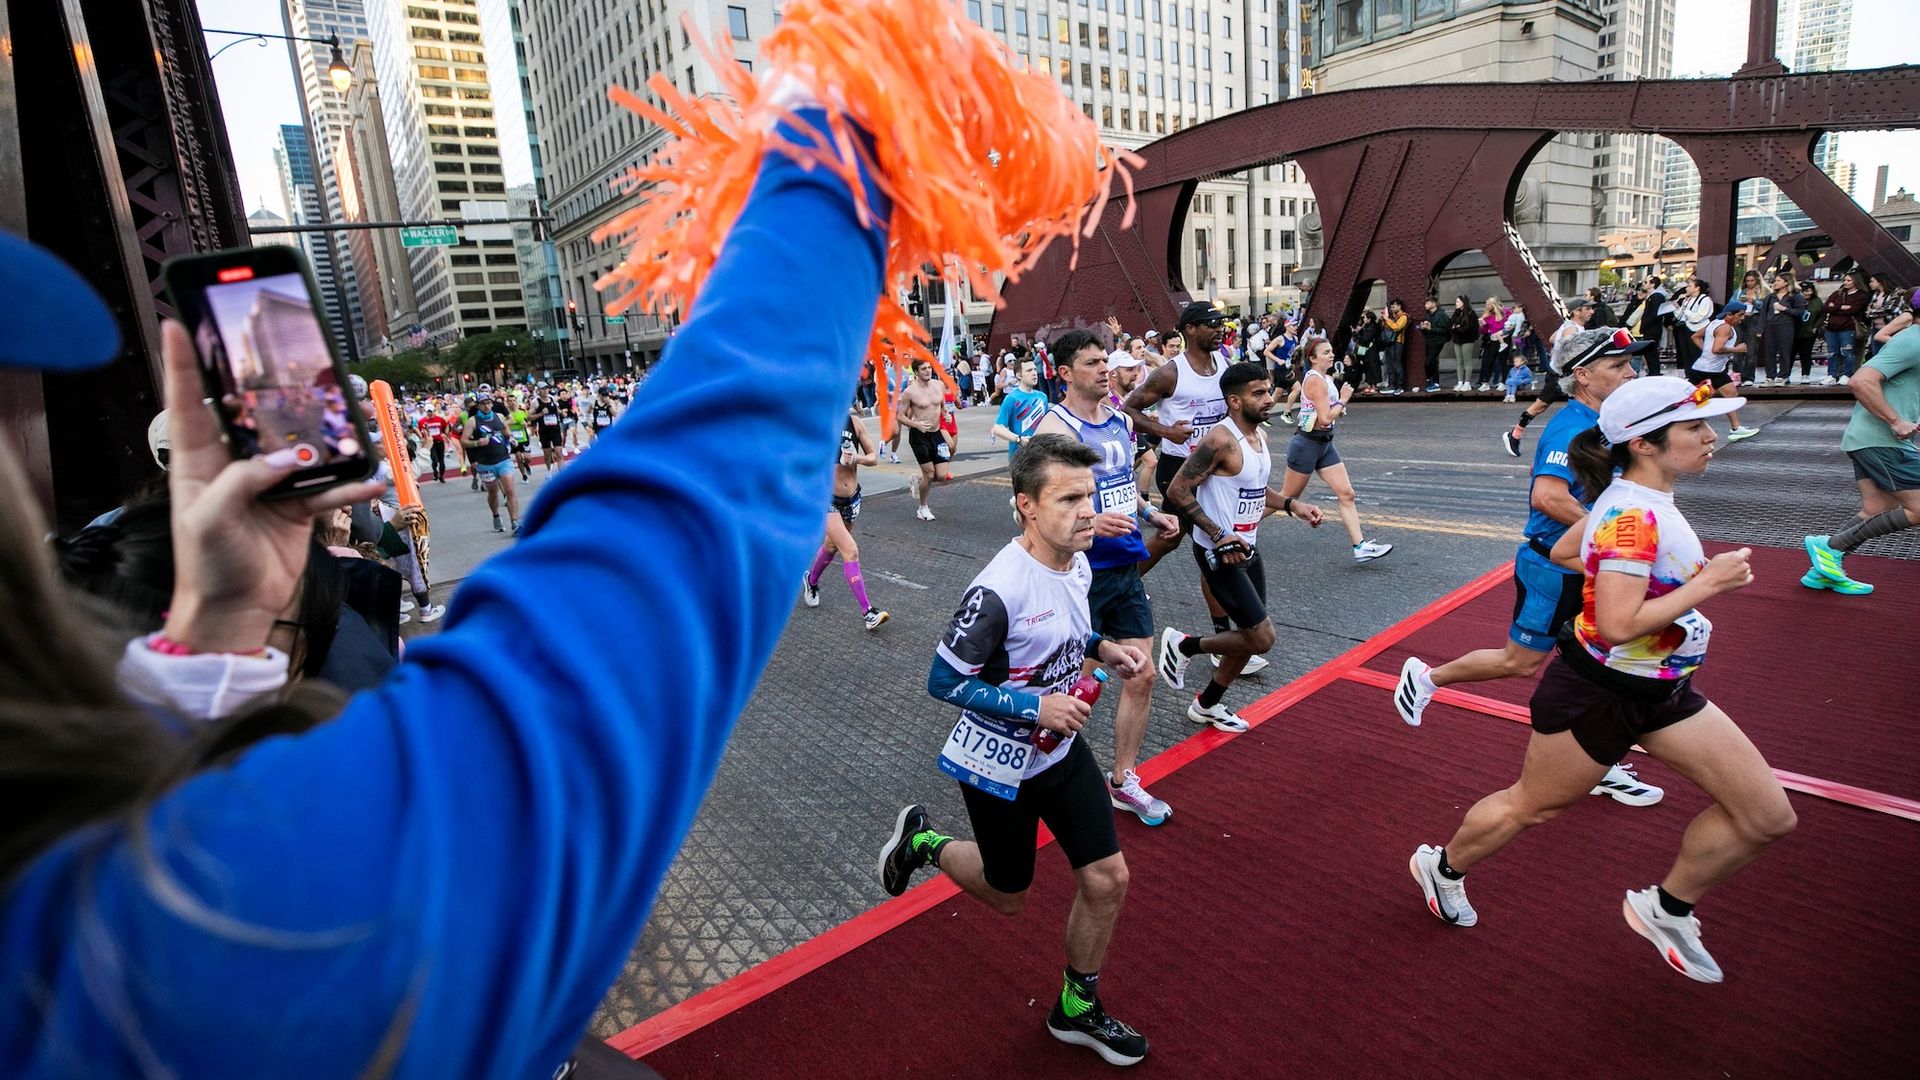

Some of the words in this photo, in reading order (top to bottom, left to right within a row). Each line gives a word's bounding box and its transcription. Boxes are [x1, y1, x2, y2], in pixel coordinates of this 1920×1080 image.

[409, 228, 445, 238] WACKER
[1616, 515, 1635, 547] OTSO
[952, 720, 1027, 770] E17988
